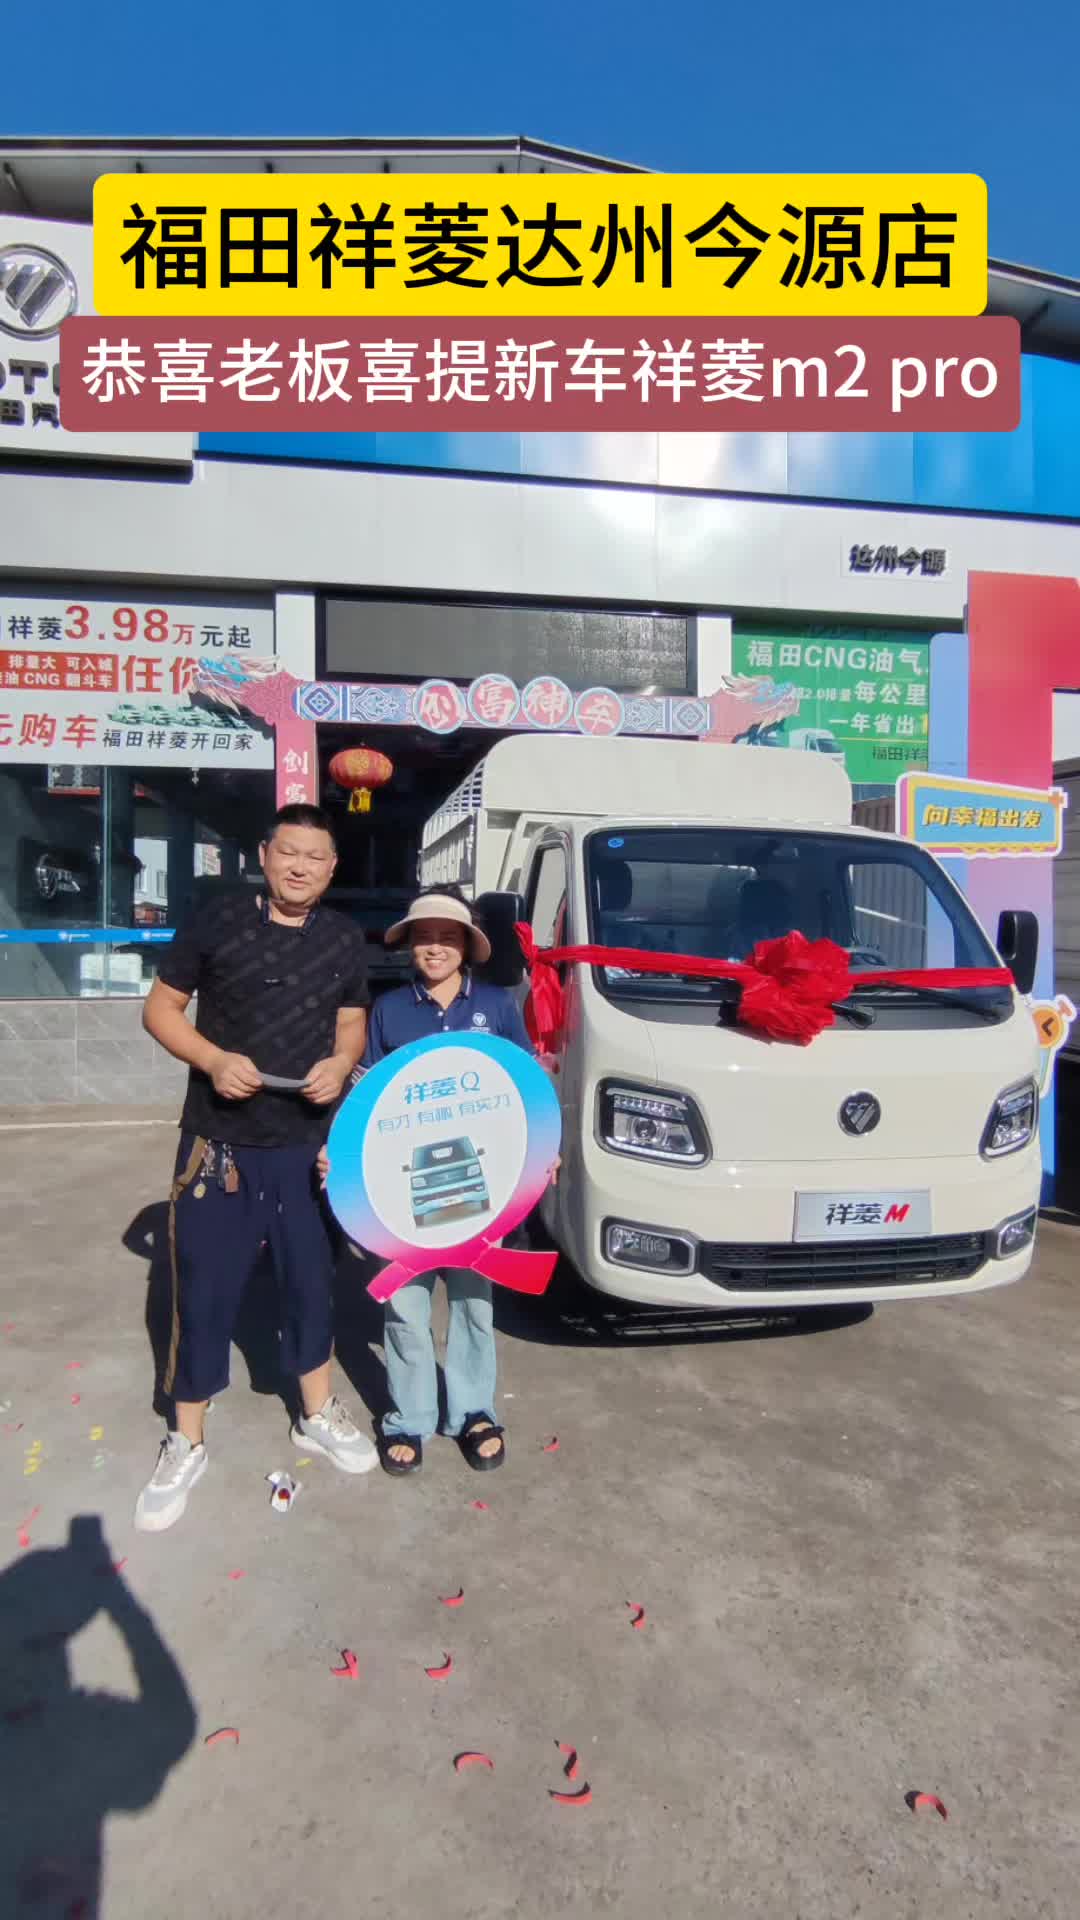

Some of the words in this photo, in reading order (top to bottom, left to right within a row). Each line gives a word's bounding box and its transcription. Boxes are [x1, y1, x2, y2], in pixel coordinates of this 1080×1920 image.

[849, 544, 947, 576] 达州今源
[0, 604, 252, 649] 祥菱3.98万元起
[8, 654, 57, 670] 排量大
[747, 640, 928, 675] 福田CNG油气
[24, 673, 60, 686] CNG
[828, 712, 928, 737] 一年省出
[102, 729, 254, 751] 福田祥菱开回家
[922, 804, 1042, 829] 向幸福出发
[825, 1202, 911, 1226] 祥菱M
